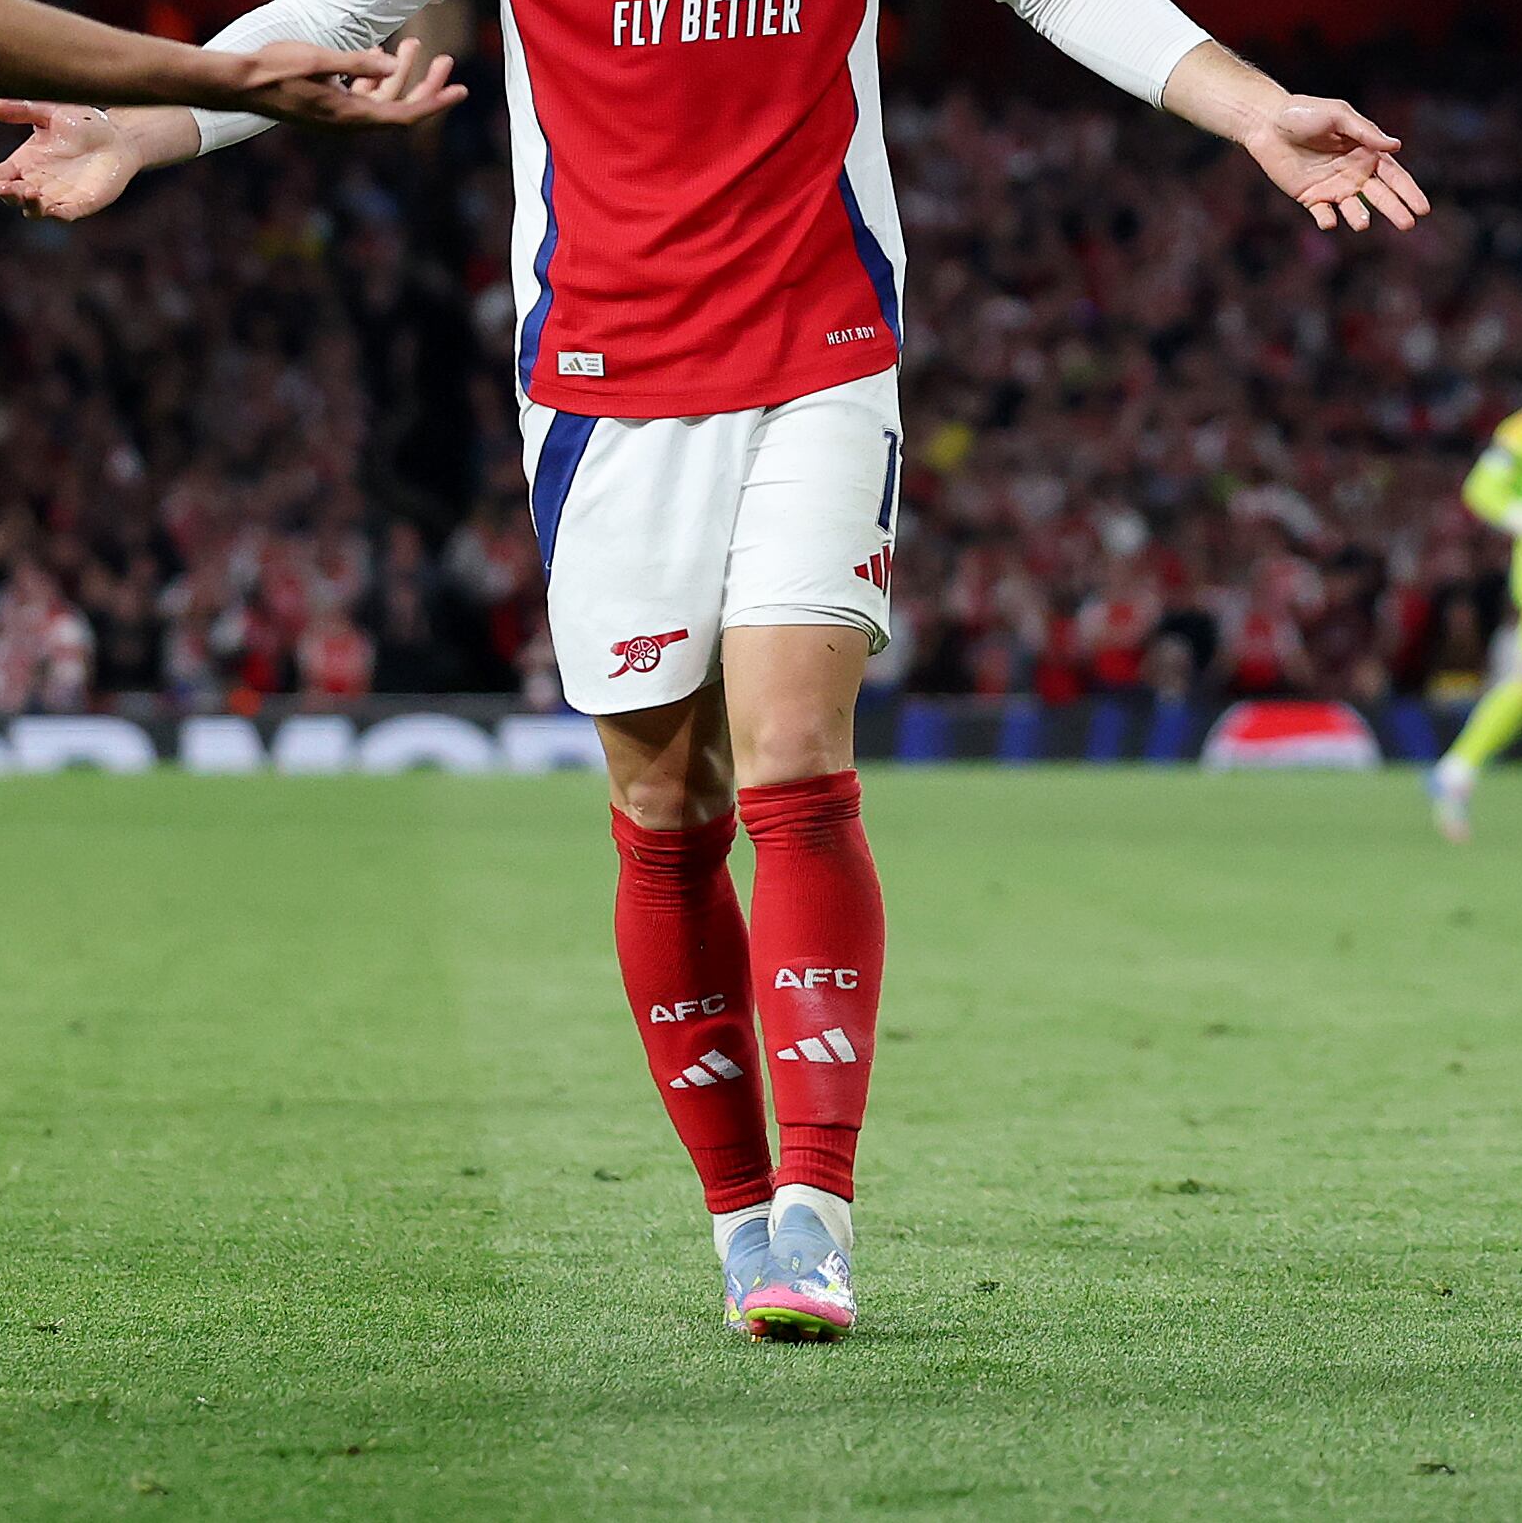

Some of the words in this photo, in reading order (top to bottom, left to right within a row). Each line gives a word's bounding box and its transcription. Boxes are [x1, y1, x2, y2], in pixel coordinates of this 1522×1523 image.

[826, 326, 876, 346] HEAT.RDY
[774, 967, 859, 990] AFC
[650, 993, 726, 1024] AFC
